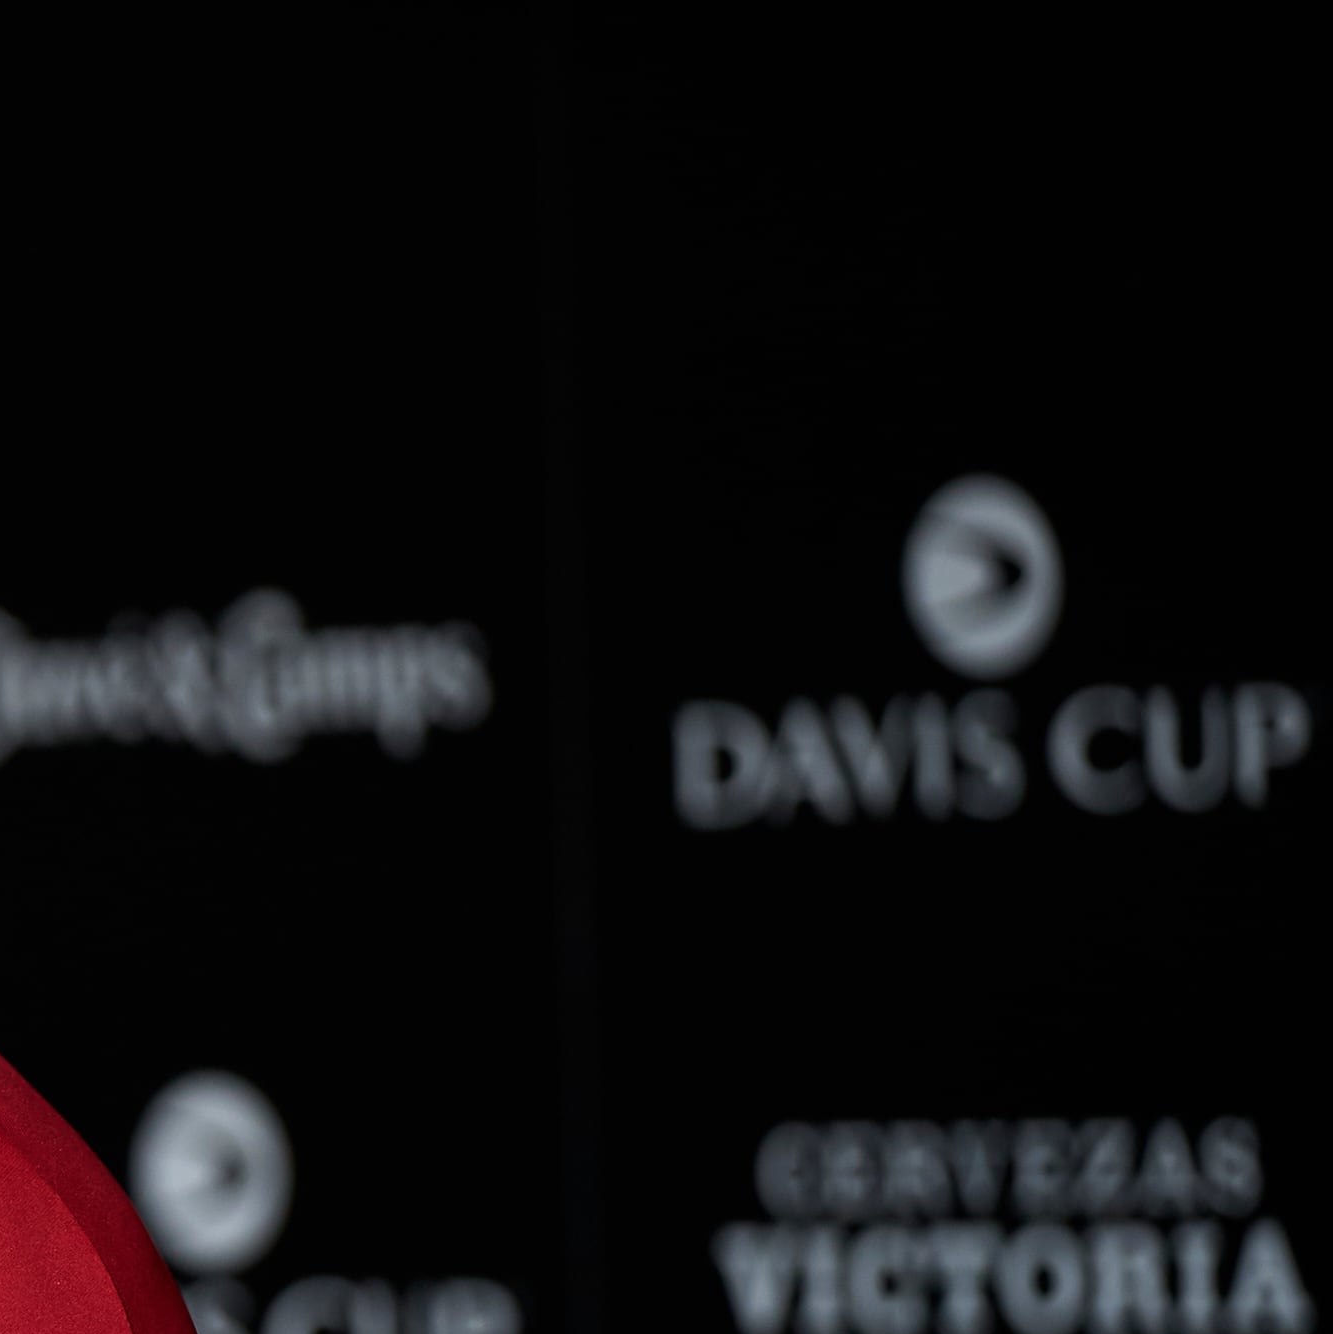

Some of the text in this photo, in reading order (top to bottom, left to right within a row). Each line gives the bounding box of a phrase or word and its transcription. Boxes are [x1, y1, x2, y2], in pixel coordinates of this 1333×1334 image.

[671, 679, 1314, 831] DAVIS CUP
[753, 1113, 1267, 1217] CERVEZAS
